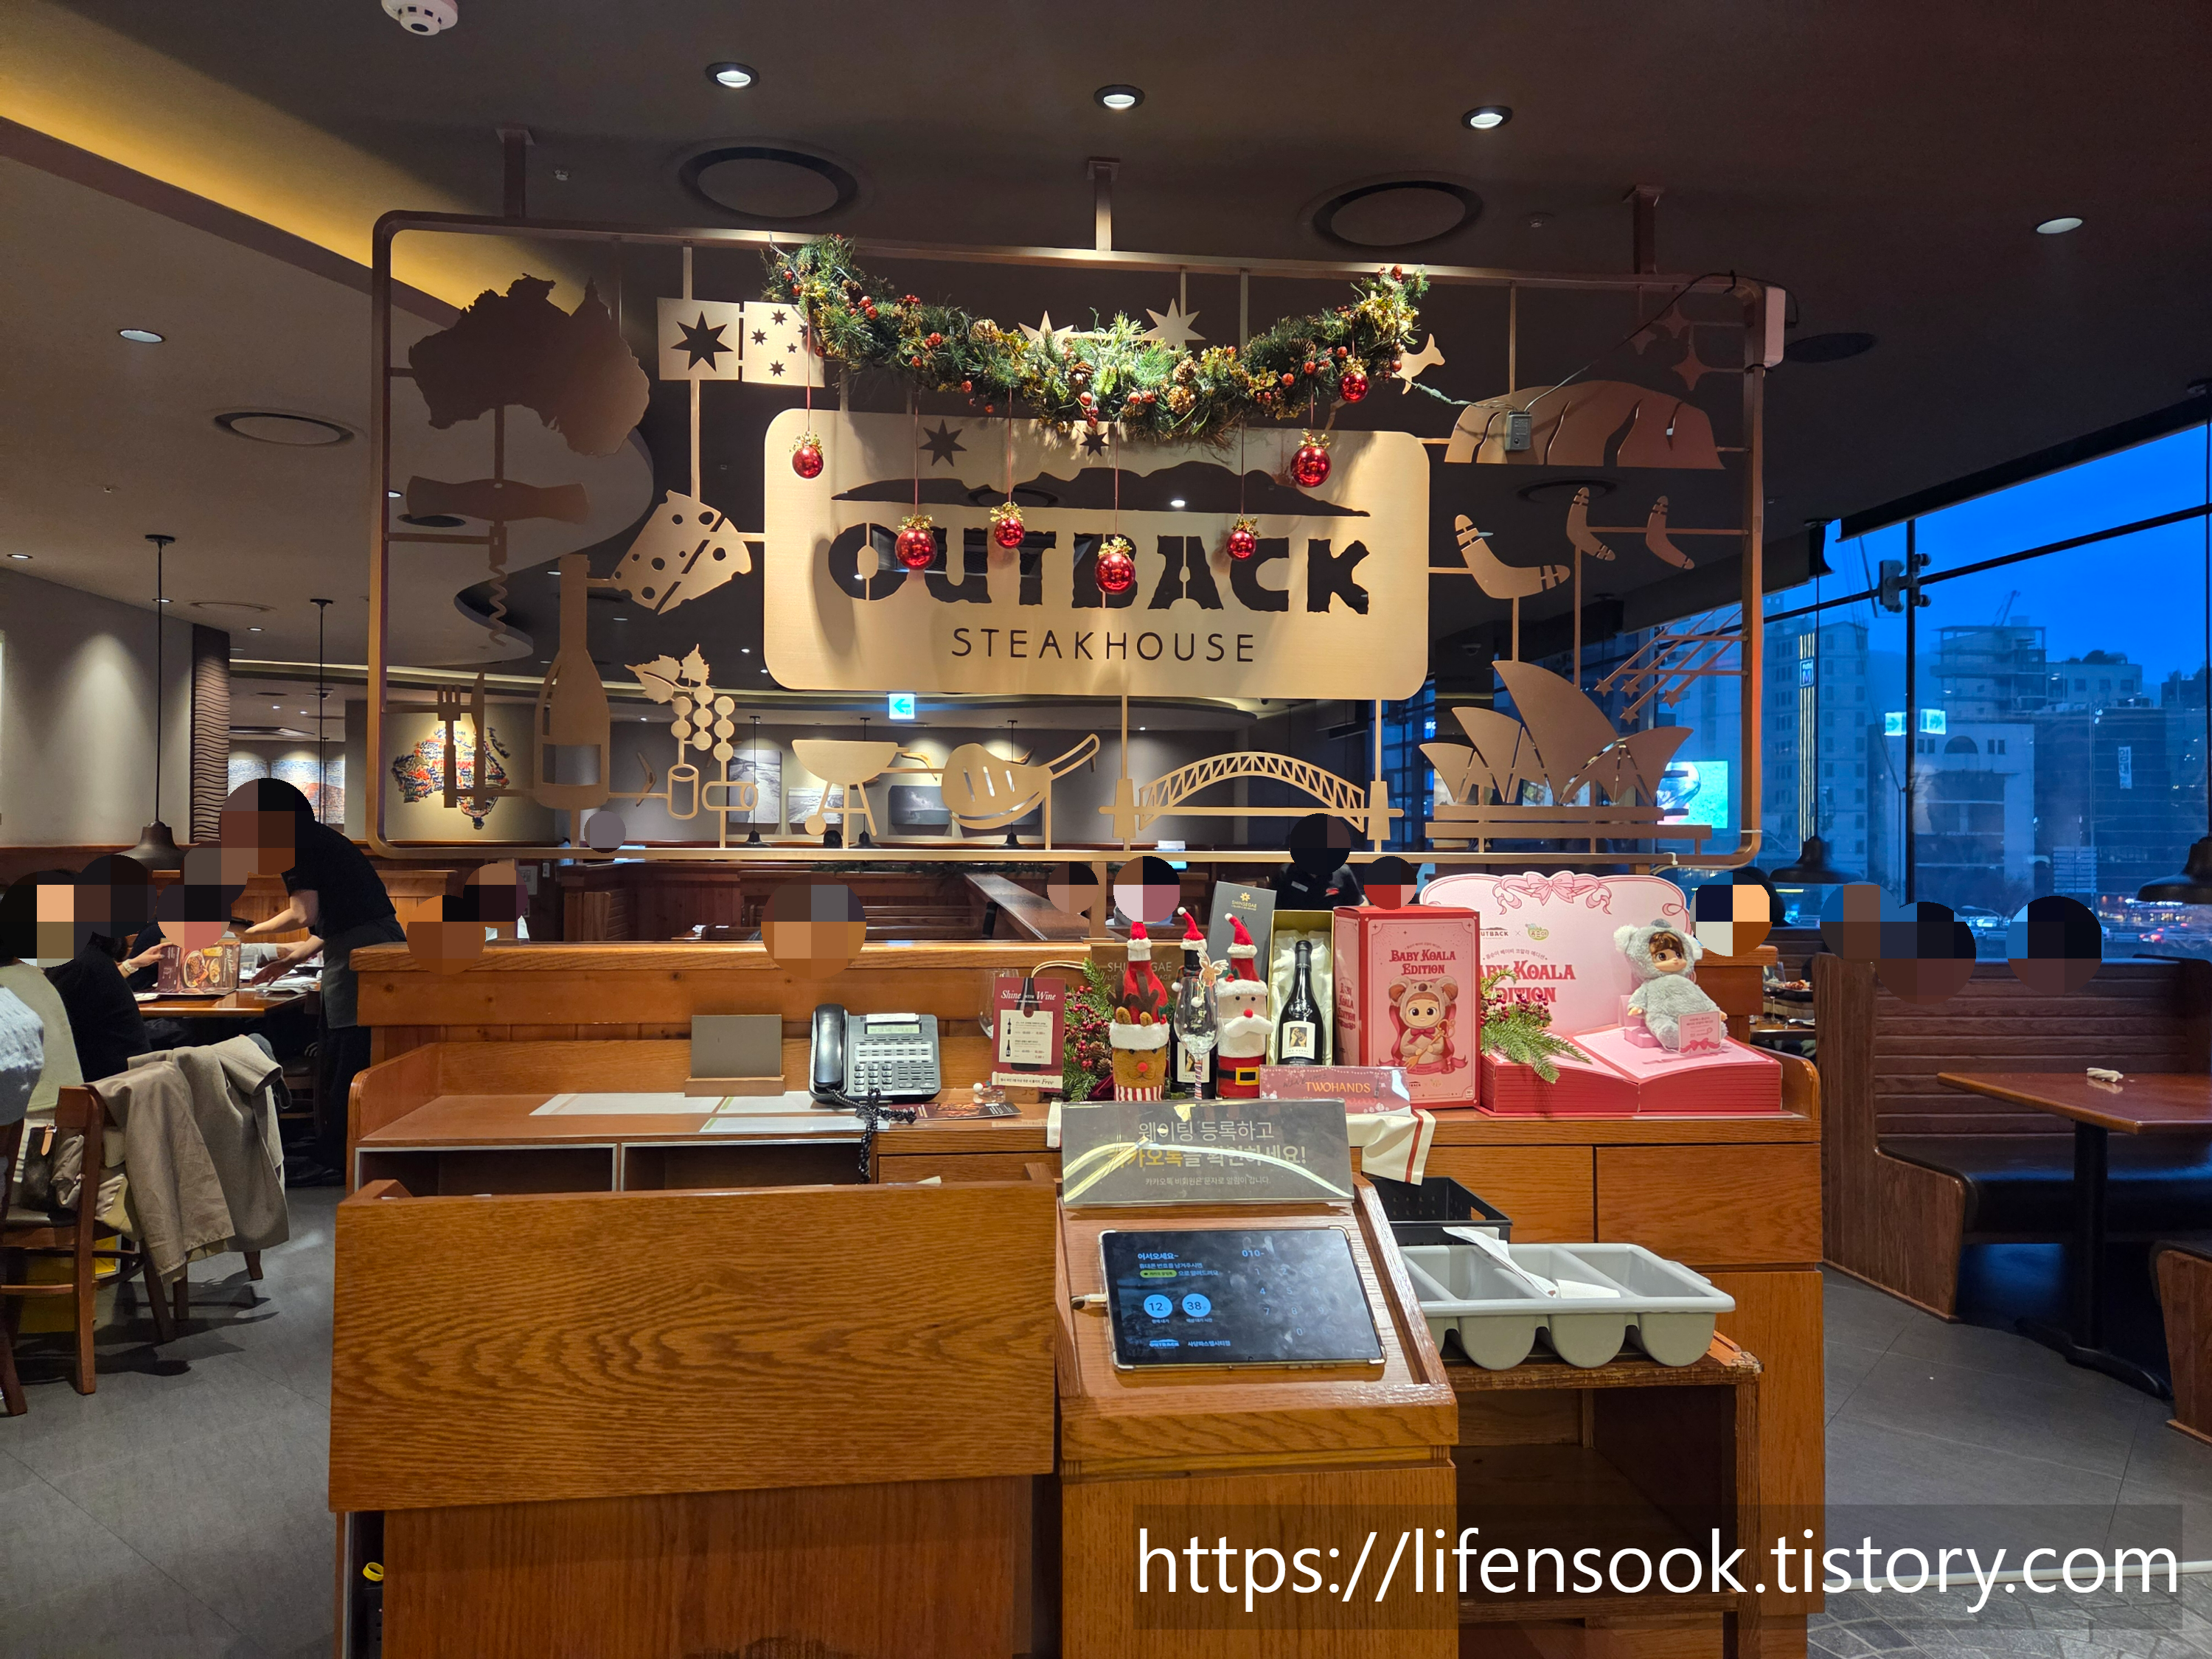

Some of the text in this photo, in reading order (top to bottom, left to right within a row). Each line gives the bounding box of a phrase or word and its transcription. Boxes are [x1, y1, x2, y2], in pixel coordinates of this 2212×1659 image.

[828, 522, 1370, 615] OUTBACK
[951, 627, 1255, 663] STEAKHOUSE
[1486, 950, 1500, 959] 콩순이
[1107, 962, 1172, 972] SHIGAE
[1513, 960, 1576, 980] KOALA
[1001, 990, 1021, 1000] Shine
[1036, 991, 1056, 1001] Wine
[1489, 987, 1557, 1003] DITION
[1305, 1082, 1371, 1093] TWOHANDS
[1138, 1120, 1275, 1142] 웨이팅 등록하고
[1145, 1178, 1173, 1186] 카카오톡
[1204, 1177, 1225, 1185] 문자로
[1226, 1176, 1247, 1185] 알림이
[1149, 1302, 1164, 1312] 12
[1186, 1301, 1202, 1310] 38
[1263, 1307, 1270, 1315] 7
[1291, 1307, 1298, 1315] 8
